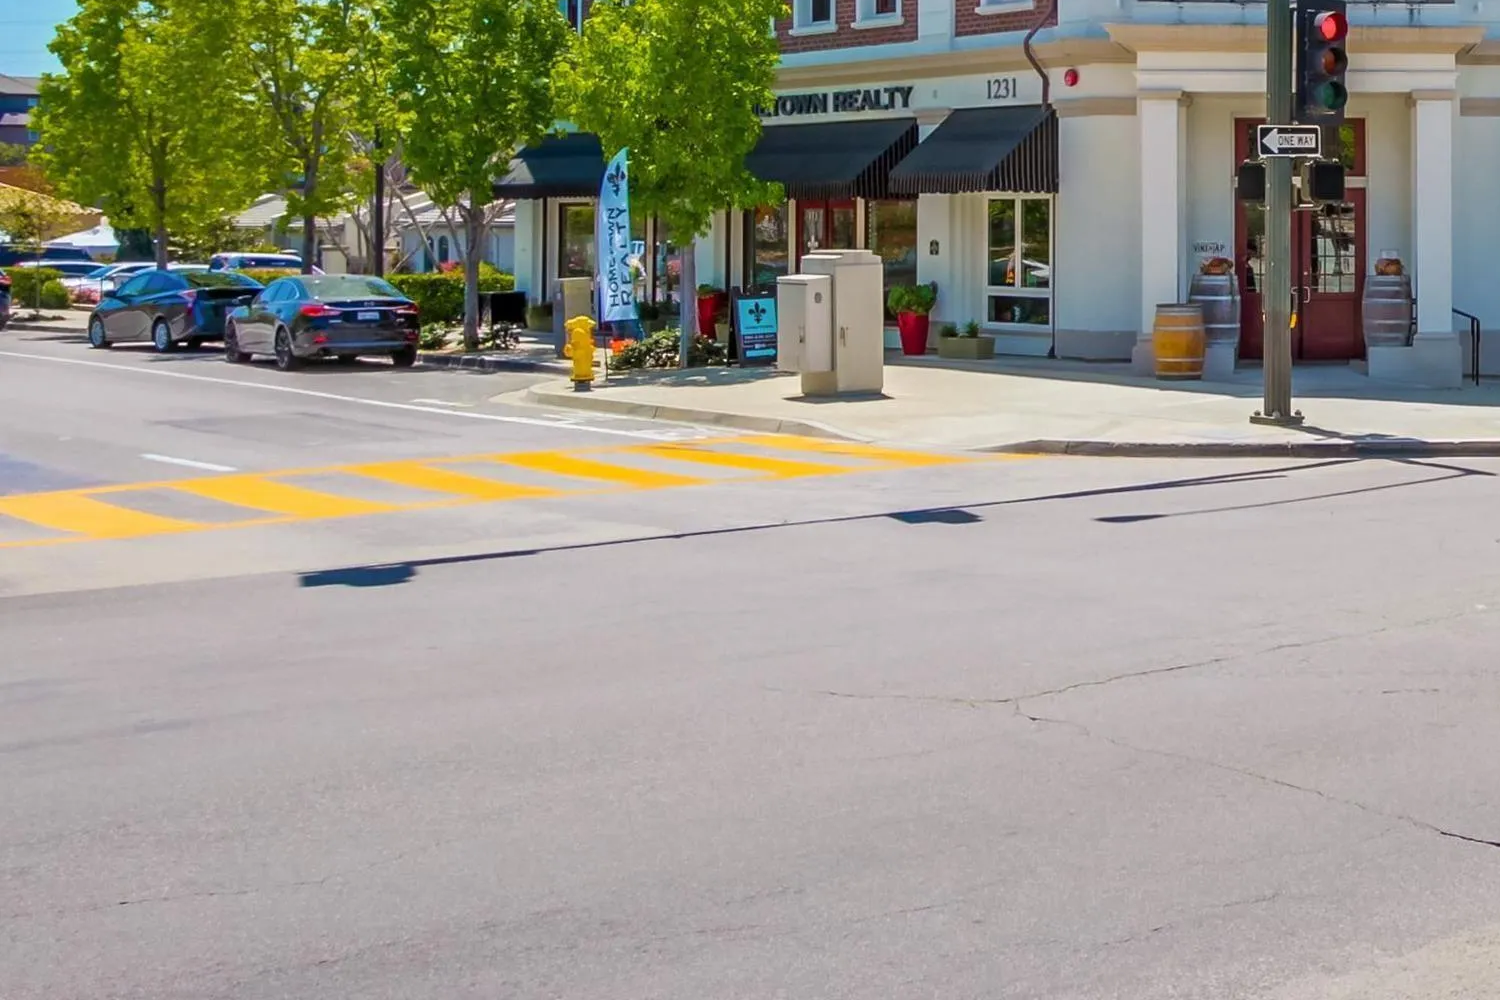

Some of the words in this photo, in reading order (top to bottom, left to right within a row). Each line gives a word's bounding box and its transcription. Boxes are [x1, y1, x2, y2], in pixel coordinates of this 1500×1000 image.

[832, 86, 914, 112] REALTY
[986, 78, 1017, 100] 1231
[1278, 135, 1295, 146] ONE
[1297, 135, 1314, 146] WAY
[616, 207, 632, 306] REALTY
